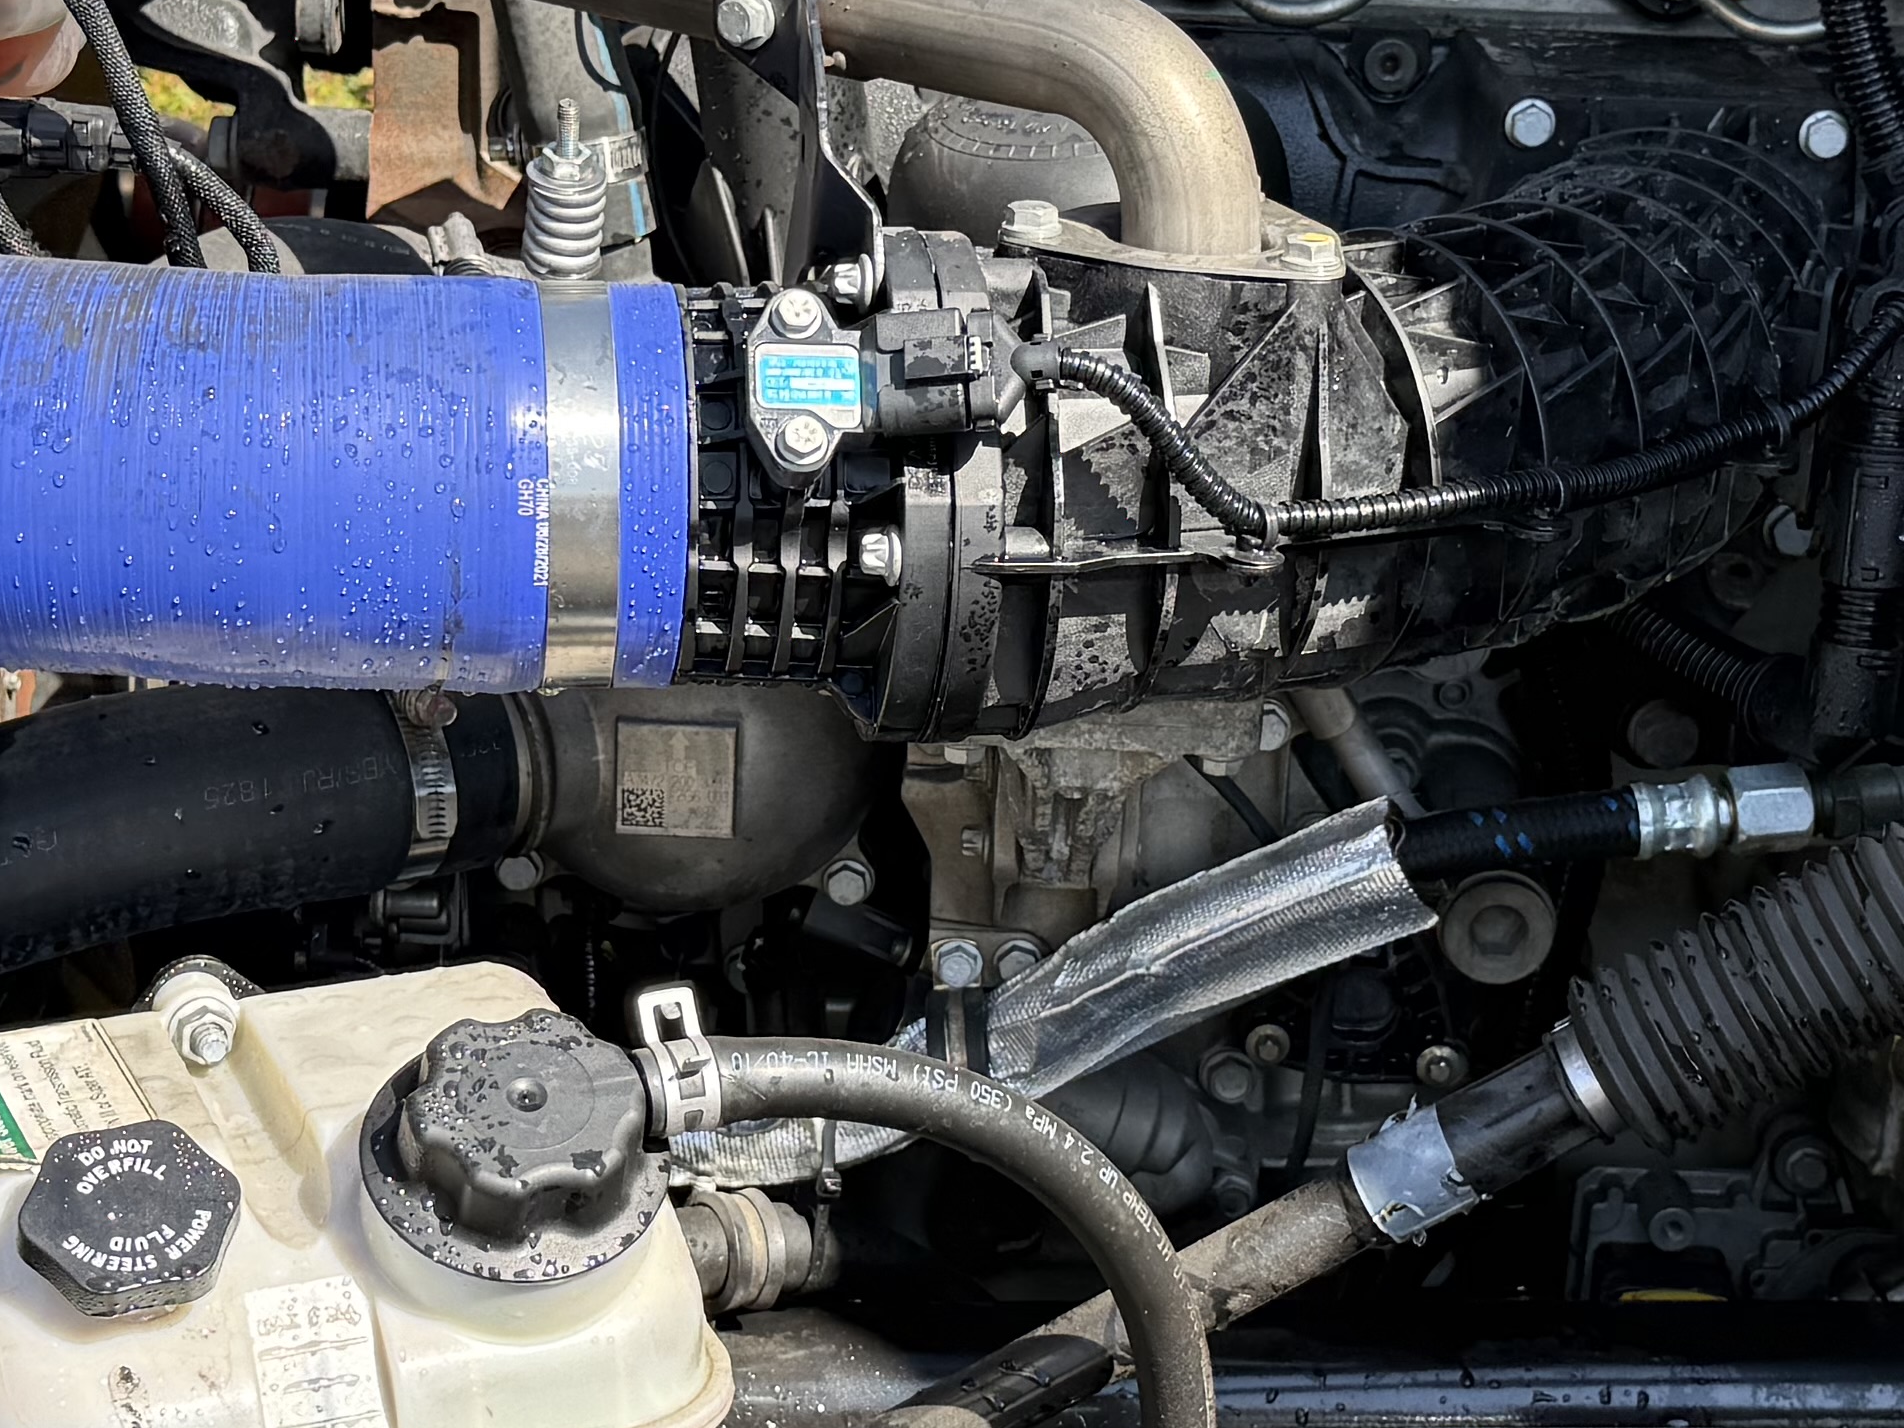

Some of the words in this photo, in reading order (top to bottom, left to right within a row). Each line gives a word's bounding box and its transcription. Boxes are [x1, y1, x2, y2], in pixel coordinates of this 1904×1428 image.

[517, 478, 535, 516] GH70
[204, 777, 272, 811] 1825
[846, 1052, 898, 1078] MSHA
[912, 1063, 959, 1093] PSI)
[970, 1082, 1014, 1114] (350
[1025, 1106, 1060, 1141] MPa
[78, 1146, 105, 1166] DO
[113, 1139, 153, 1154] NOT
[1062, 1131, 1094, 1166] 2.4
[76, 1157, 167, 1194] OVERFILL
[110, 1224, 175, 1252] FLUID
[164, 1209, 212, 1260] POWER
[1122, 1190, 1176, 1263] HI-TEMP
[61, 1235, 158, 1272] STEERING
